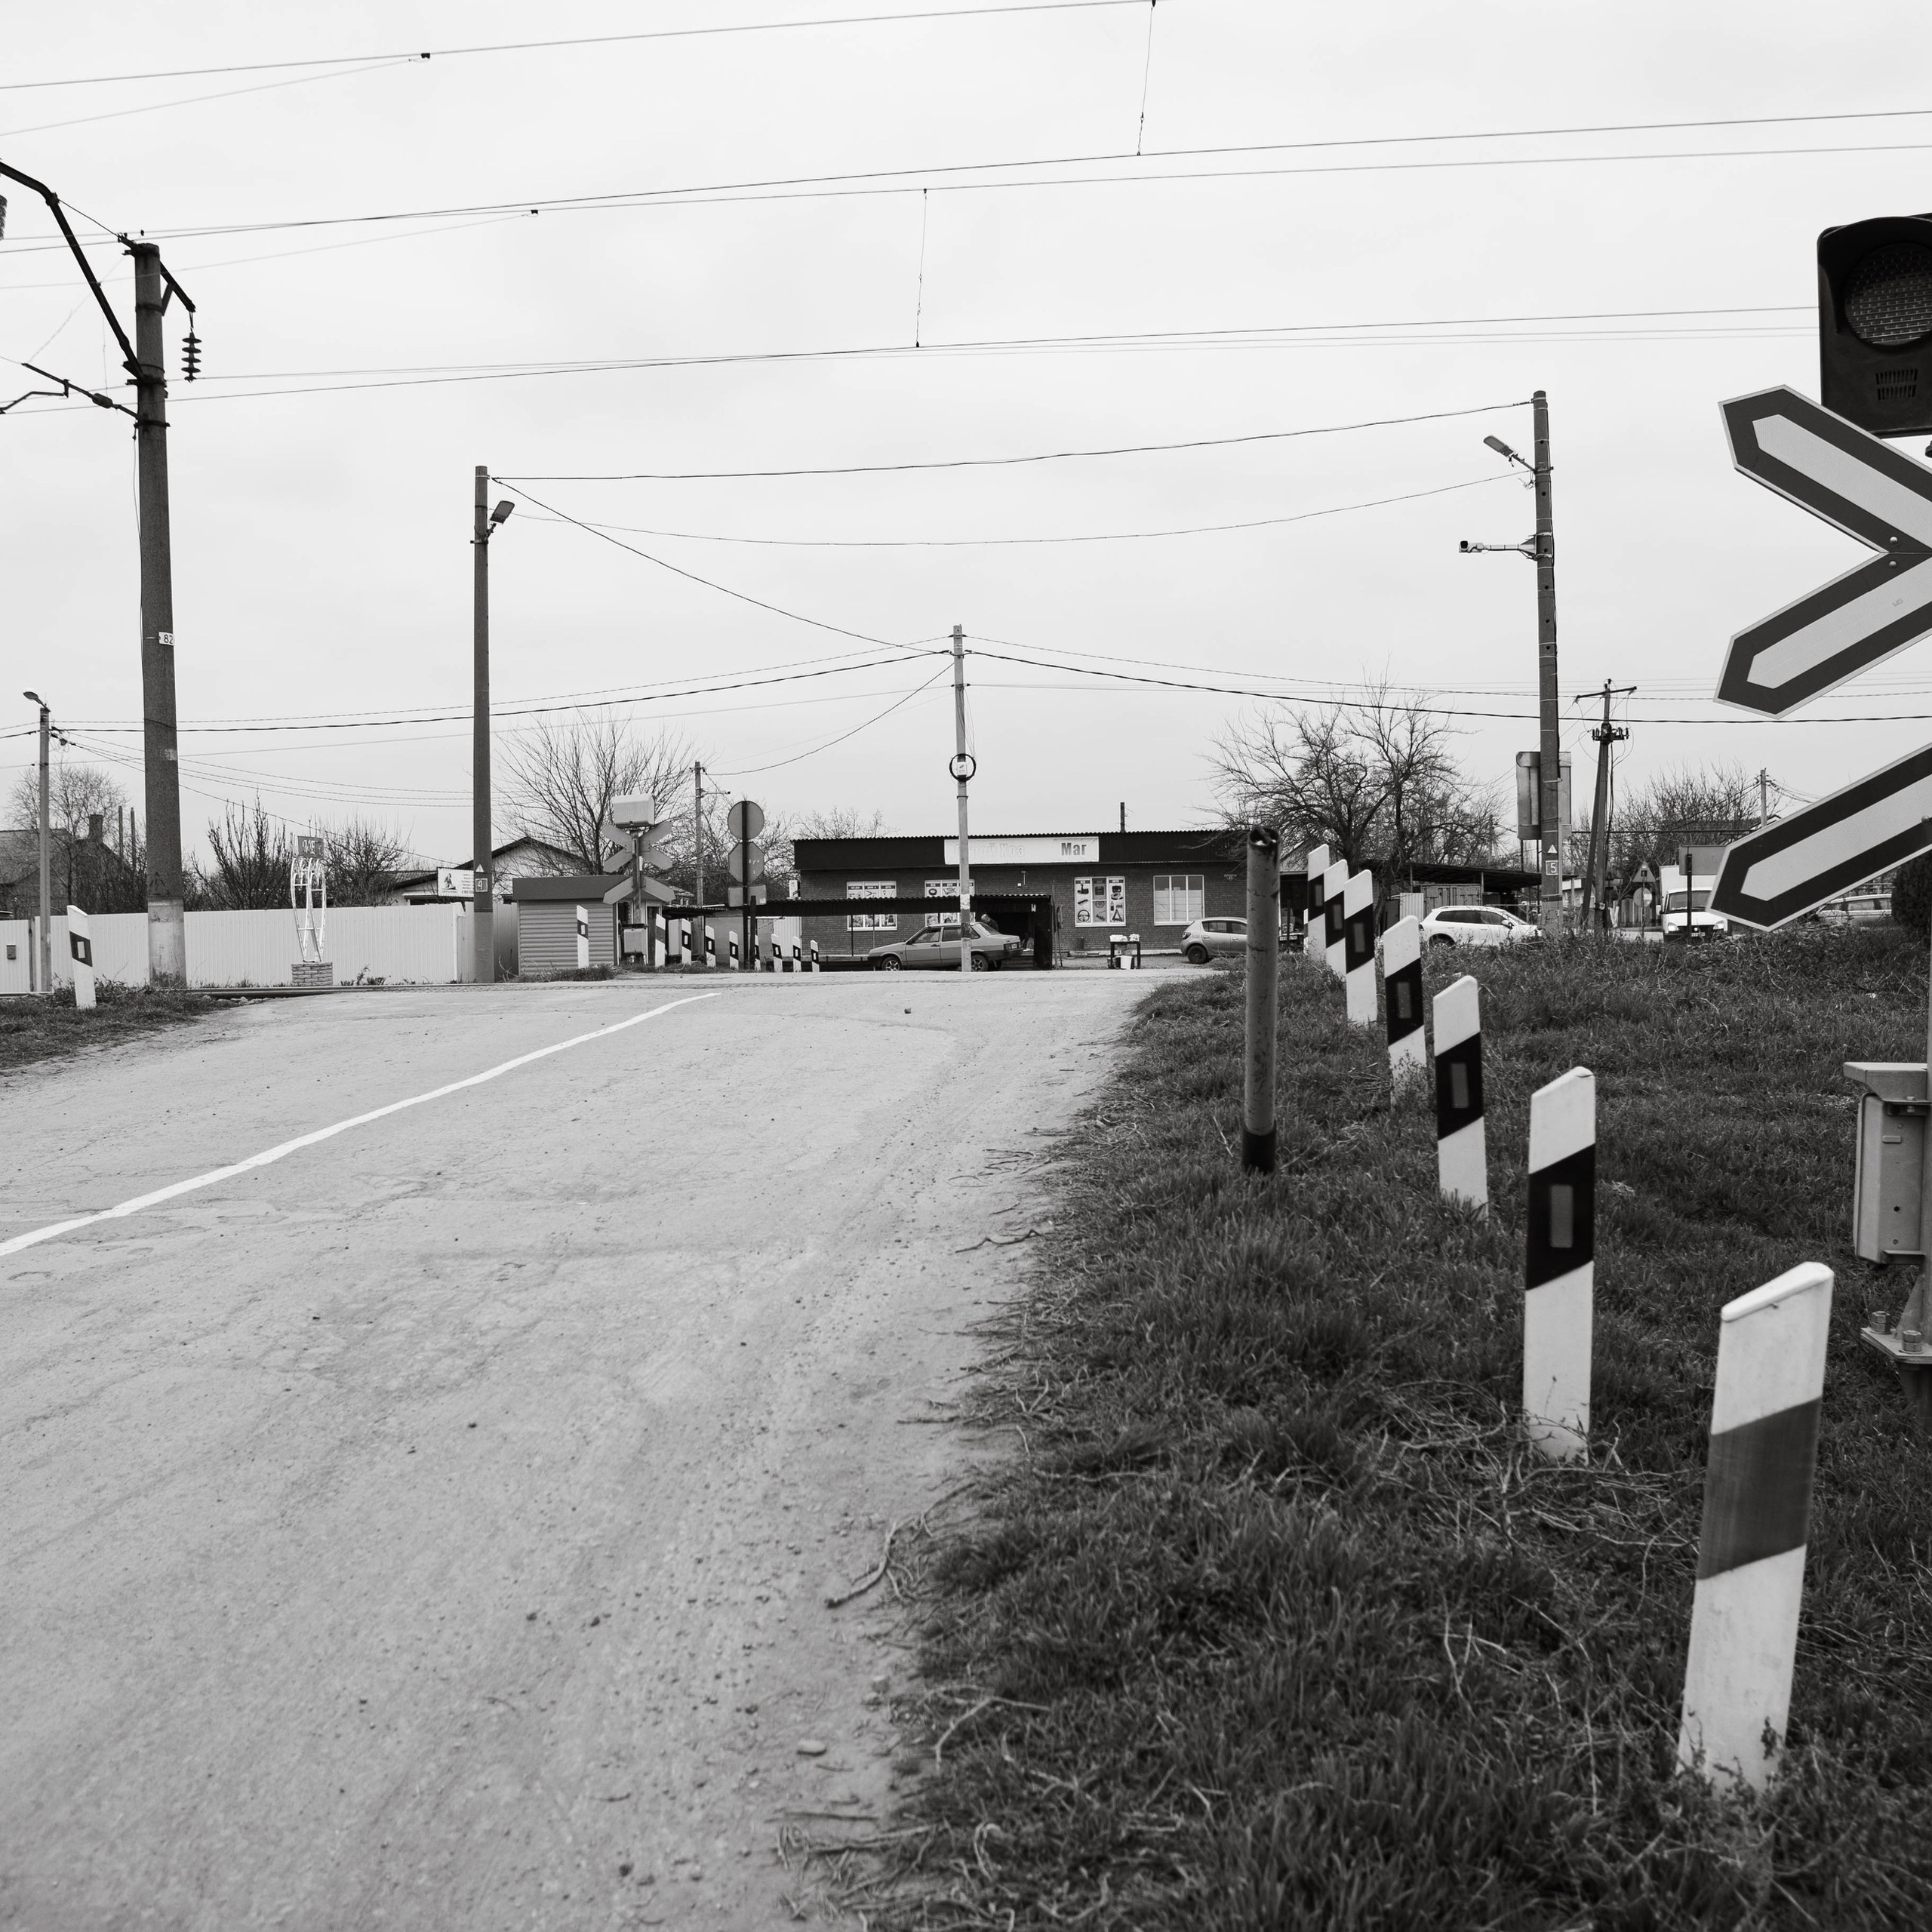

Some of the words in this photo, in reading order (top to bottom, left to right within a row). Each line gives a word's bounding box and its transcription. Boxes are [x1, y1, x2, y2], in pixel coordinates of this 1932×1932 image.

[164, 634, 174, 645] 82
[1061, 842, 1087, 856] Маг
[1550, 863, 1557, 873] 5
